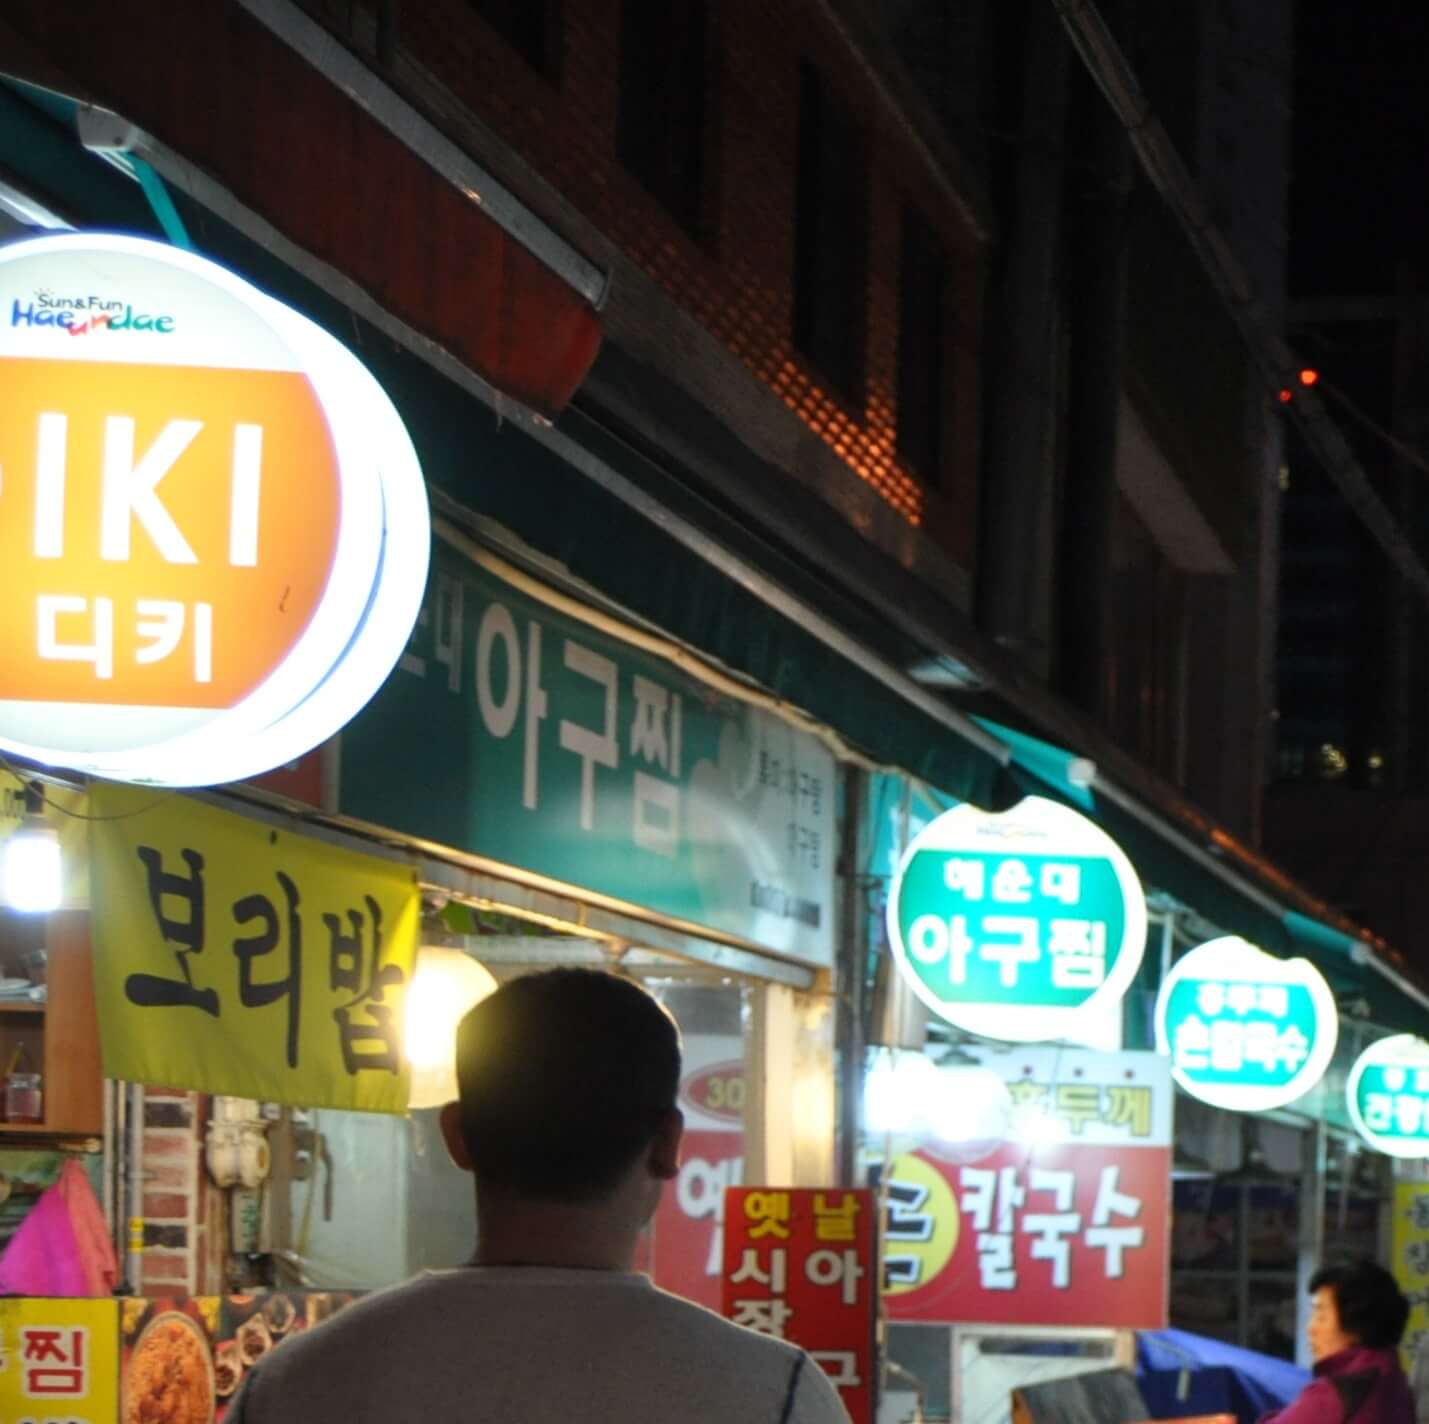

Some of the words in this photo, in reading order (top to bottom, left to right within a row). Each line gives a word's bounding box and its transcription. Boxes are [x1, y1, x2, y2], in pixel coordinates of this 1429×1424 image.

[11, 299, 175, 336] Haeundae
[37, 293, 123, 311] Sun&Fun
[36, 594, 212, 683] 디키
[476, 602, 682, 858] 아구찜
[125, 846, 405, 1075] 보리밥
[908, 914, 1107, 988] 아구찜
[744, 1191, 861, 1240] 옛날
[961, 1165, 1145, 1290] 칼국수
